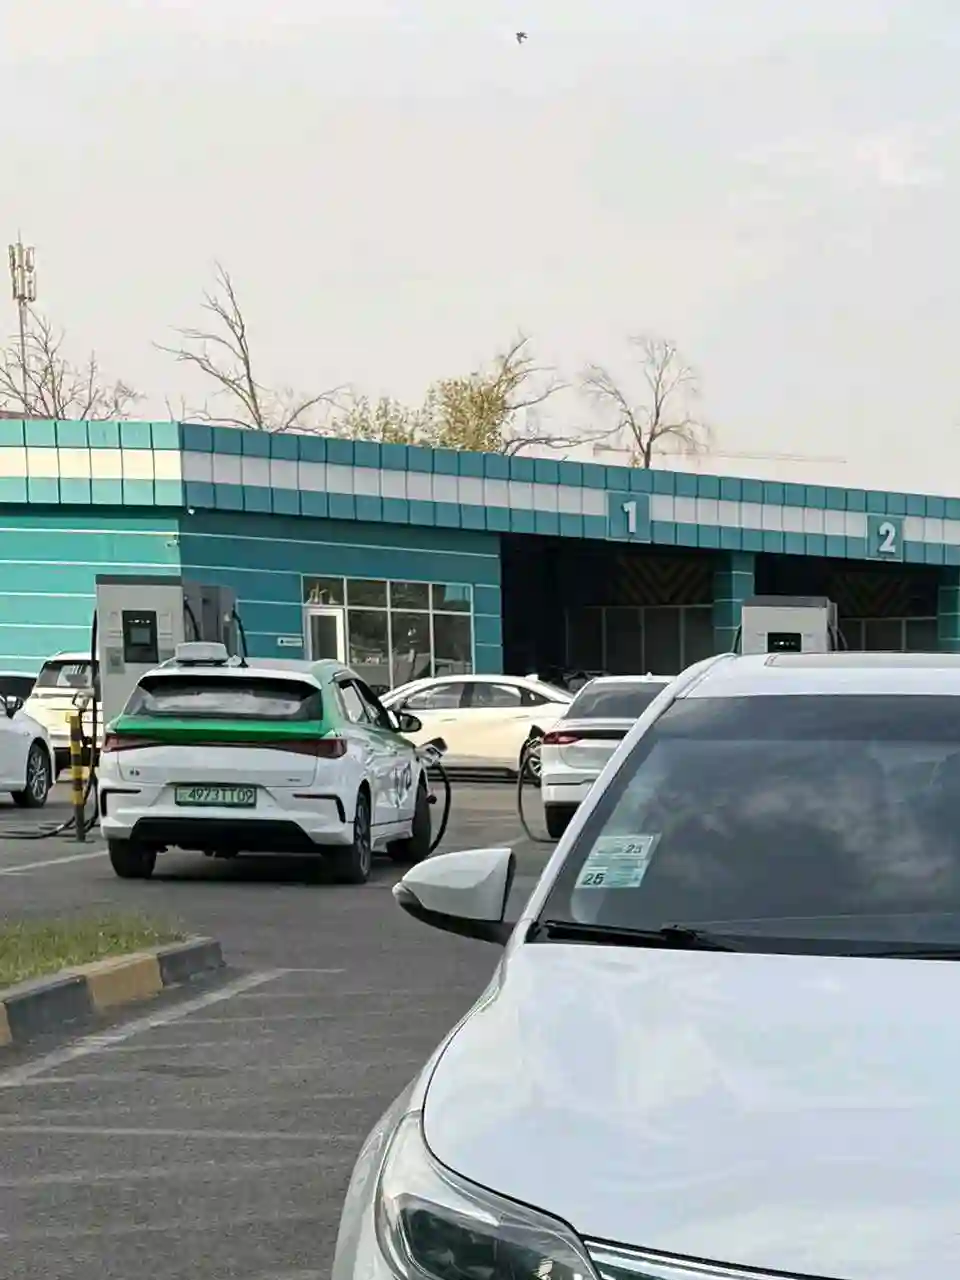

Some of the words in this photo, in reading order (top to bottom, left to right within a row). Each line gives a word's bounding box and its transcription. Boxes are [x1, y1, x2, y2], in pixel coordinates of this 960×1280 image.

[622, 501, 636, 533] 1
[878, 521, 896, 553] 2
[582, 873, 605, 886] 25
